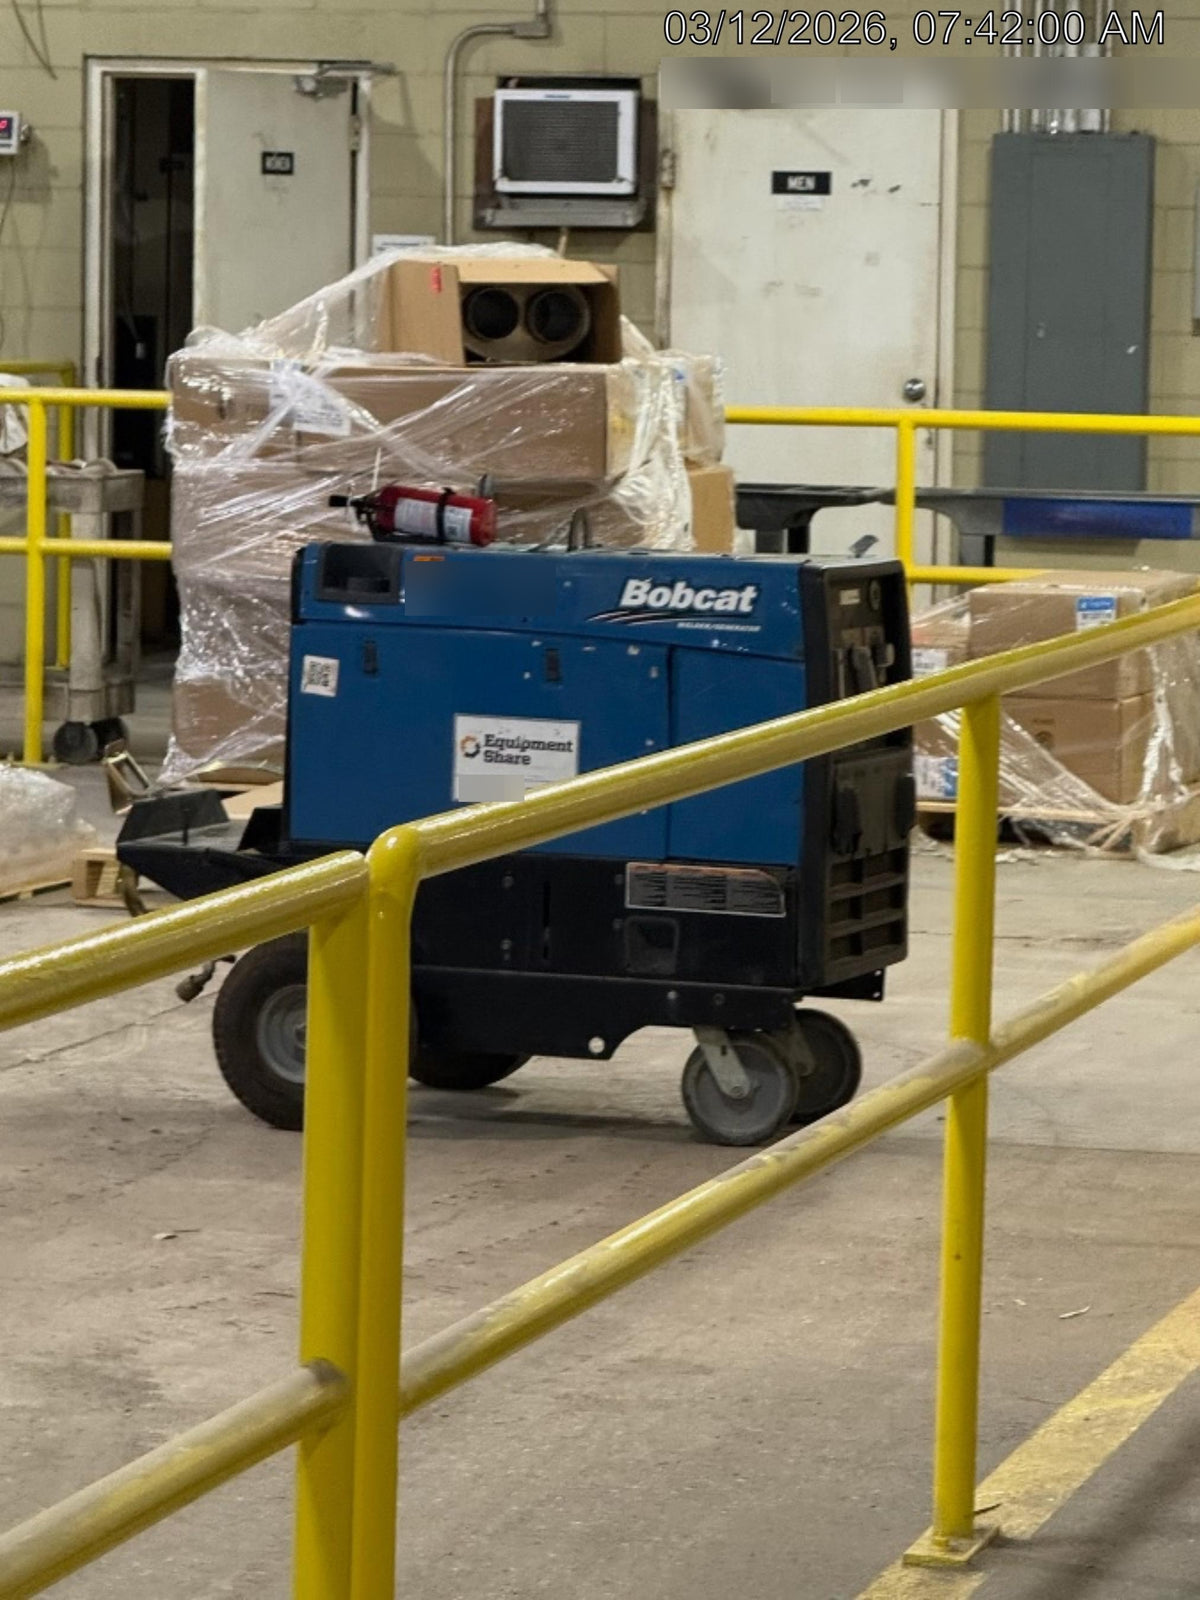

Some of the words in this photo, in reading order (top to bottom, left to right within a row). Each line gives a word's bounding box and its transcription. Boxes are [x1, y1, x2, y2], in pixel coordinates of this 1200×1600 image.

[786, 175, 816, 191] MEN
[618, 577, 758, 612] Bobcat
[483, 733, 574, 753] Equipment
[483, 749, 532, 766] Share
